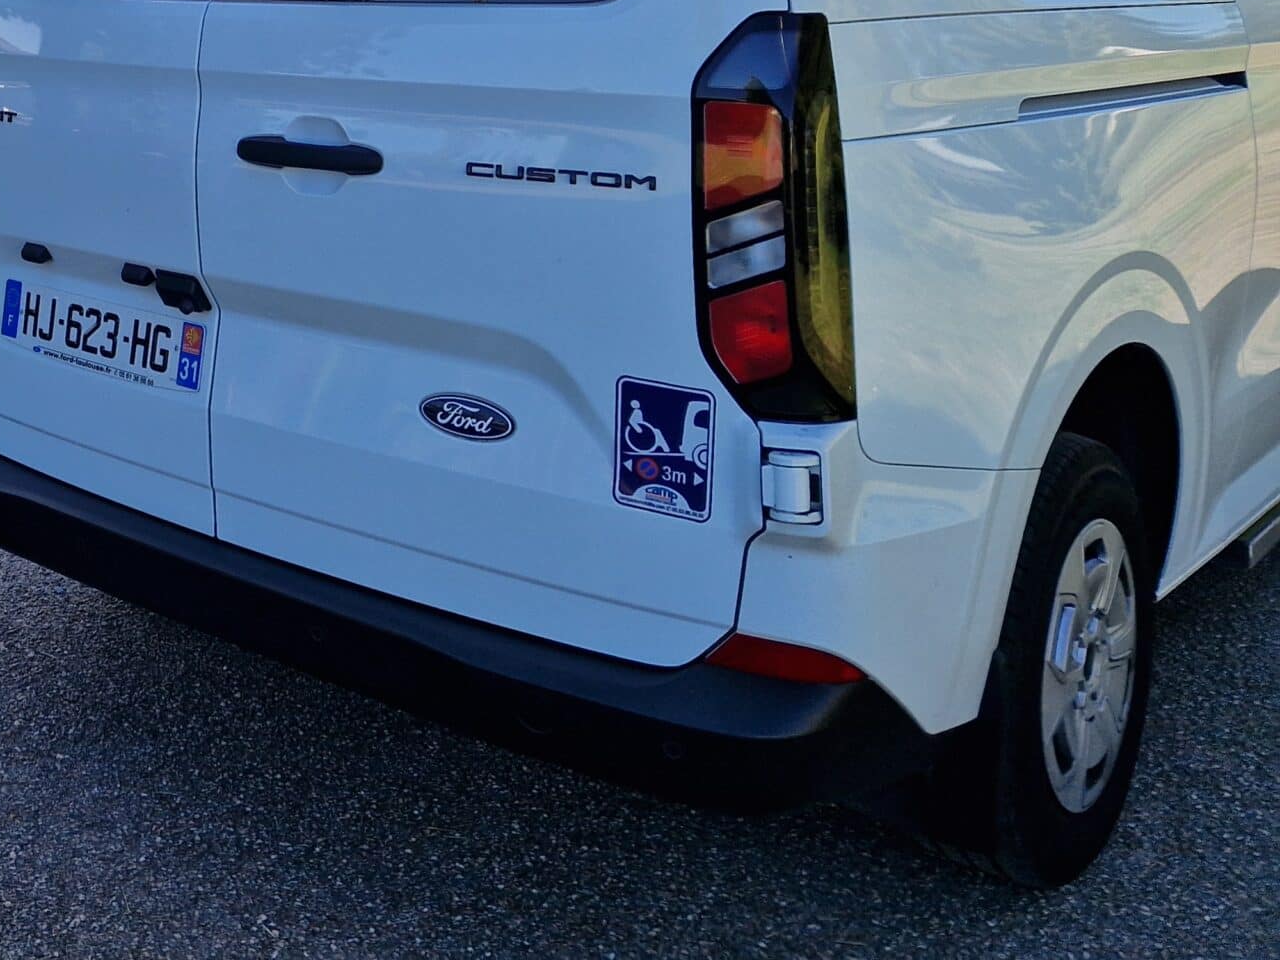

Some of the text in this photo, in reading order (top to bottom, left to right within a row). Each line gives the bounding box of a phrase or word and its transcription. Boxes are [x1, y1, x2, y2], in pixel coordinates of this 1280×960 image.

[466, 161, 657, 191] CUSTOM
[6, 313, 15, 327] F
[179, 357, 199, 384] 31
[436, 401, 494, 434] Ford
[661, 465, 687, 485] 3m
[645, 486, 678, 504] camp
